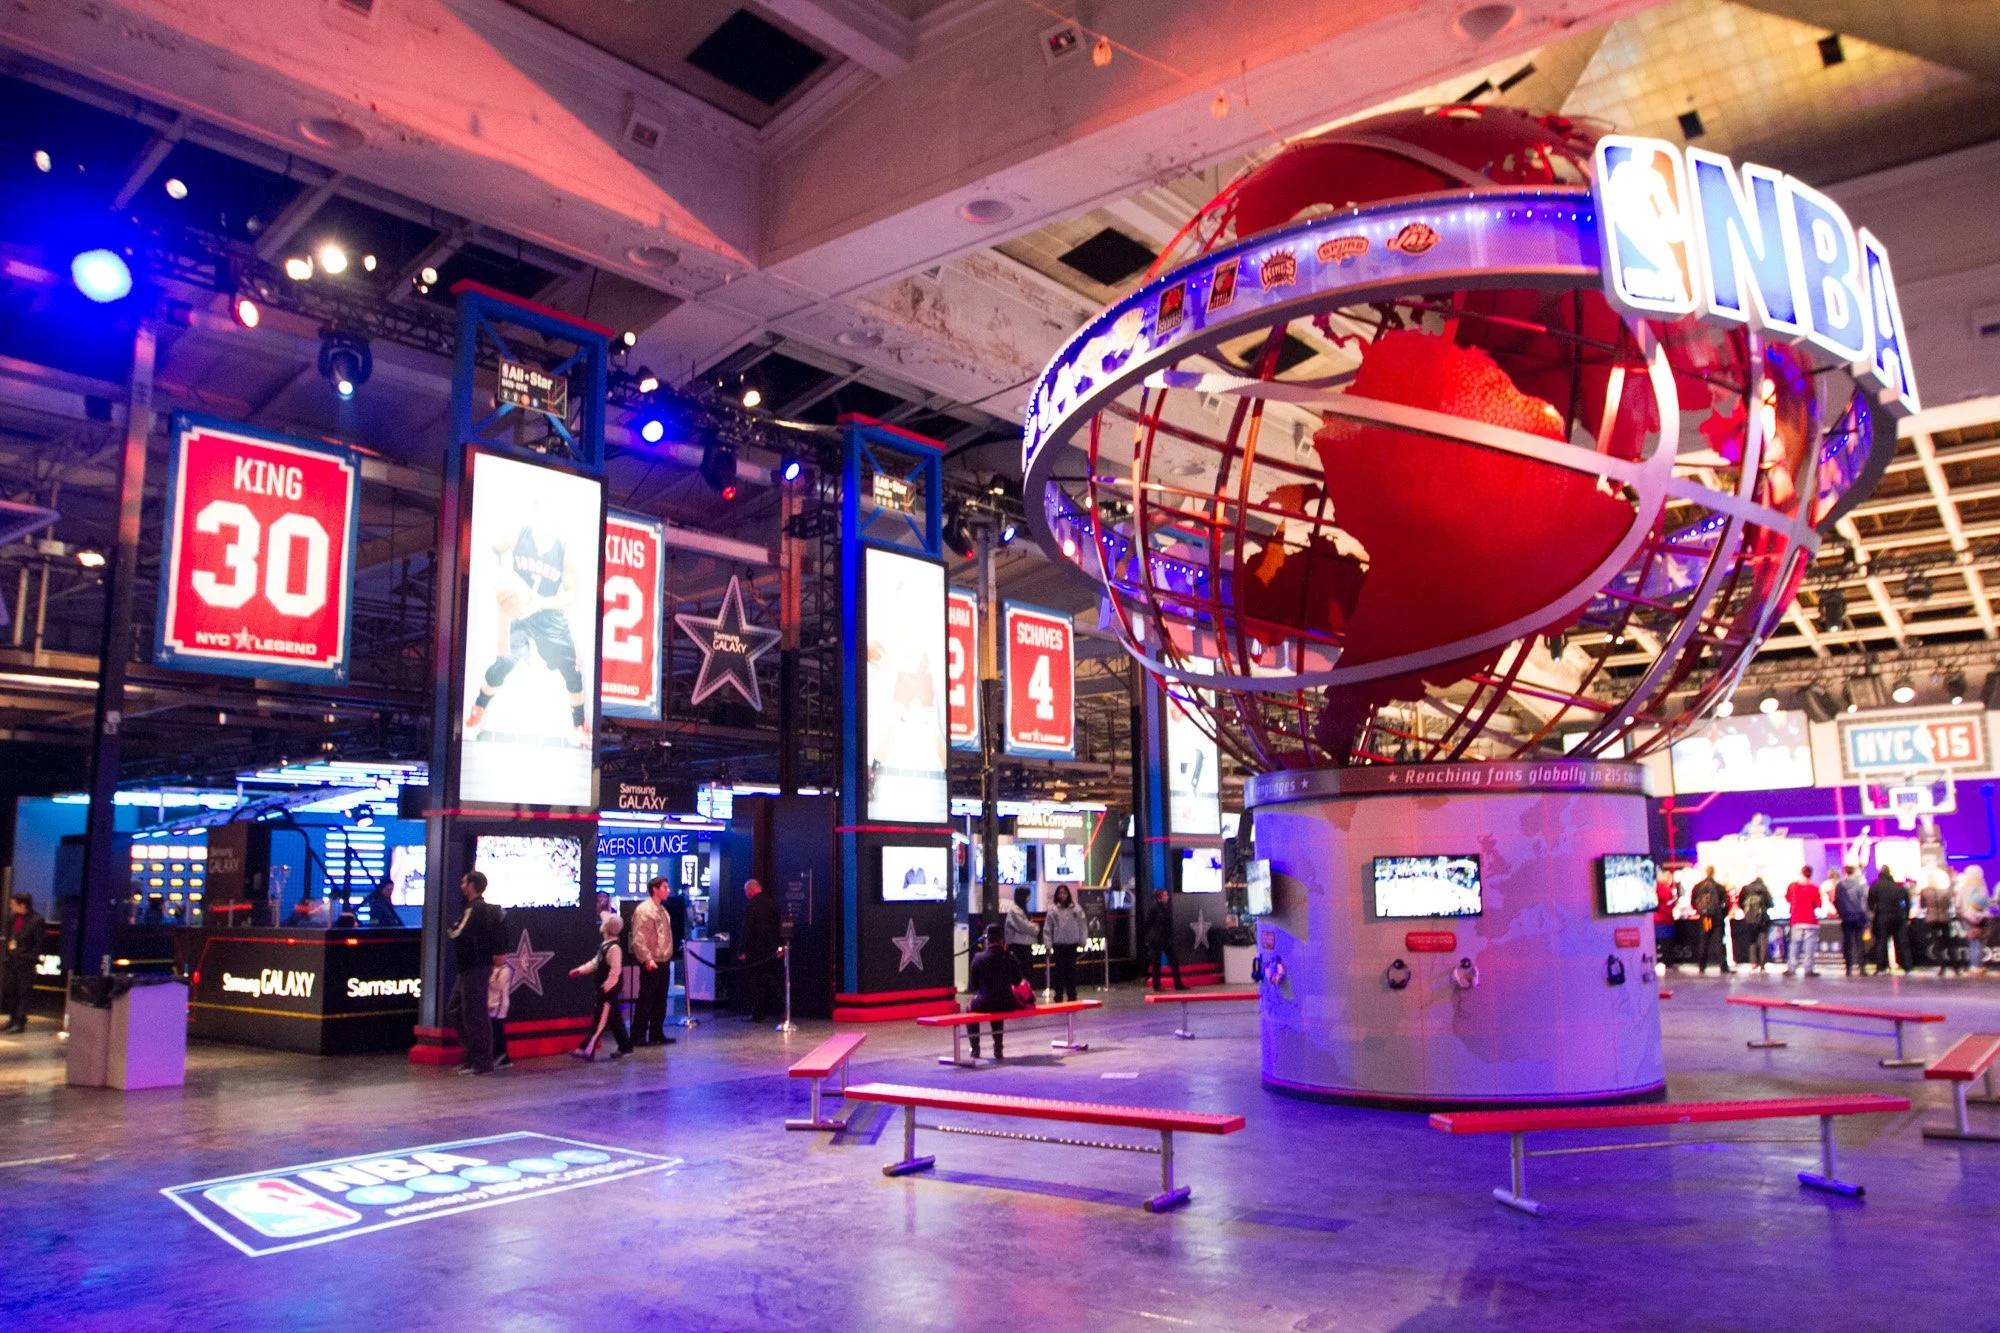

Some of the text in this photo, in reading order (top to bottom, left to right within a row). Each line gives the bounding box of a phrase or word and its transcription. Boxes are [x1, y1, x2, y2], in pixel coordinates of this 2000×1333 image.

[1262, 260, 1295, 283] KINGS
[1685, 147, 1921, 414] NBA
[234, 456, 303, 501] KING
[191, 499, 329, 618] 30
[602, 575, 643, 664] 2
[196, 631, 317, 655] NYC LEGEND
[713, 631, 740, 643] Samsung
[713, 639, 748, 654] GALAXY
[1016, 621, 1064, 651] SCHAYES
[1028, 655, 1054, 721] 4
[1856, 725, 1970, 764] NYC 15
[1405, 768, 1481, 785] Reaching
[1487, 767, 1523, 785] fans
[1529, 766, 1586, 785] globally
[1590, 766, 1601, 781] in
[1605, 768, 1620, 782] 215
[619, 795, 667, 810] GALAXY
[620, 783, 656, 797] Samsung
[598, 837, 635, 855] AYERS
[637, 834, 688, 855] LOUNGE
[261, 968, 315, 998] GALAXY
[347, 977, 421, 998] Samsung
[297, 1152, 489, 1192] NBA
